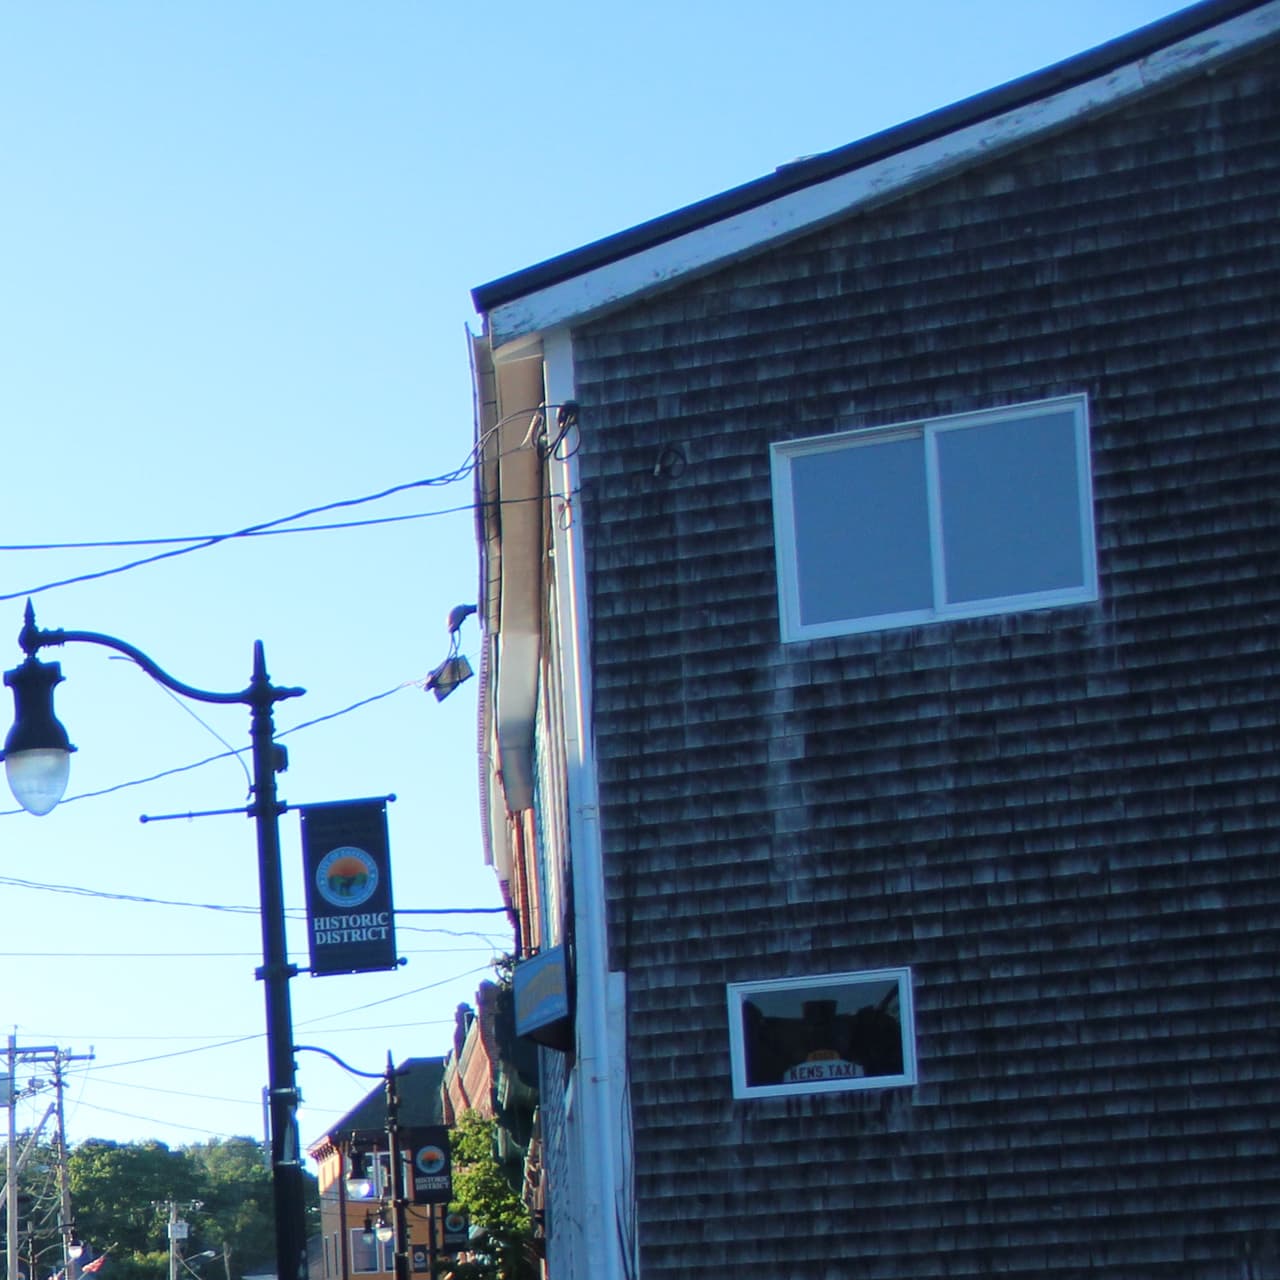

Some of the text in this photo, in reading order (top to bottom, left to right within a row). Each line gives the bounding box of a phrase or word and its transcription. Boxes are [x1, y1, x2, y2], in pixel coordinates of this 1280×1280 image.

[314, 911, 389, 931] HISTORIC
[315, 926, 389, 945] DISTRICT
[790, 1063, 857, 1081] KENS TAXI
